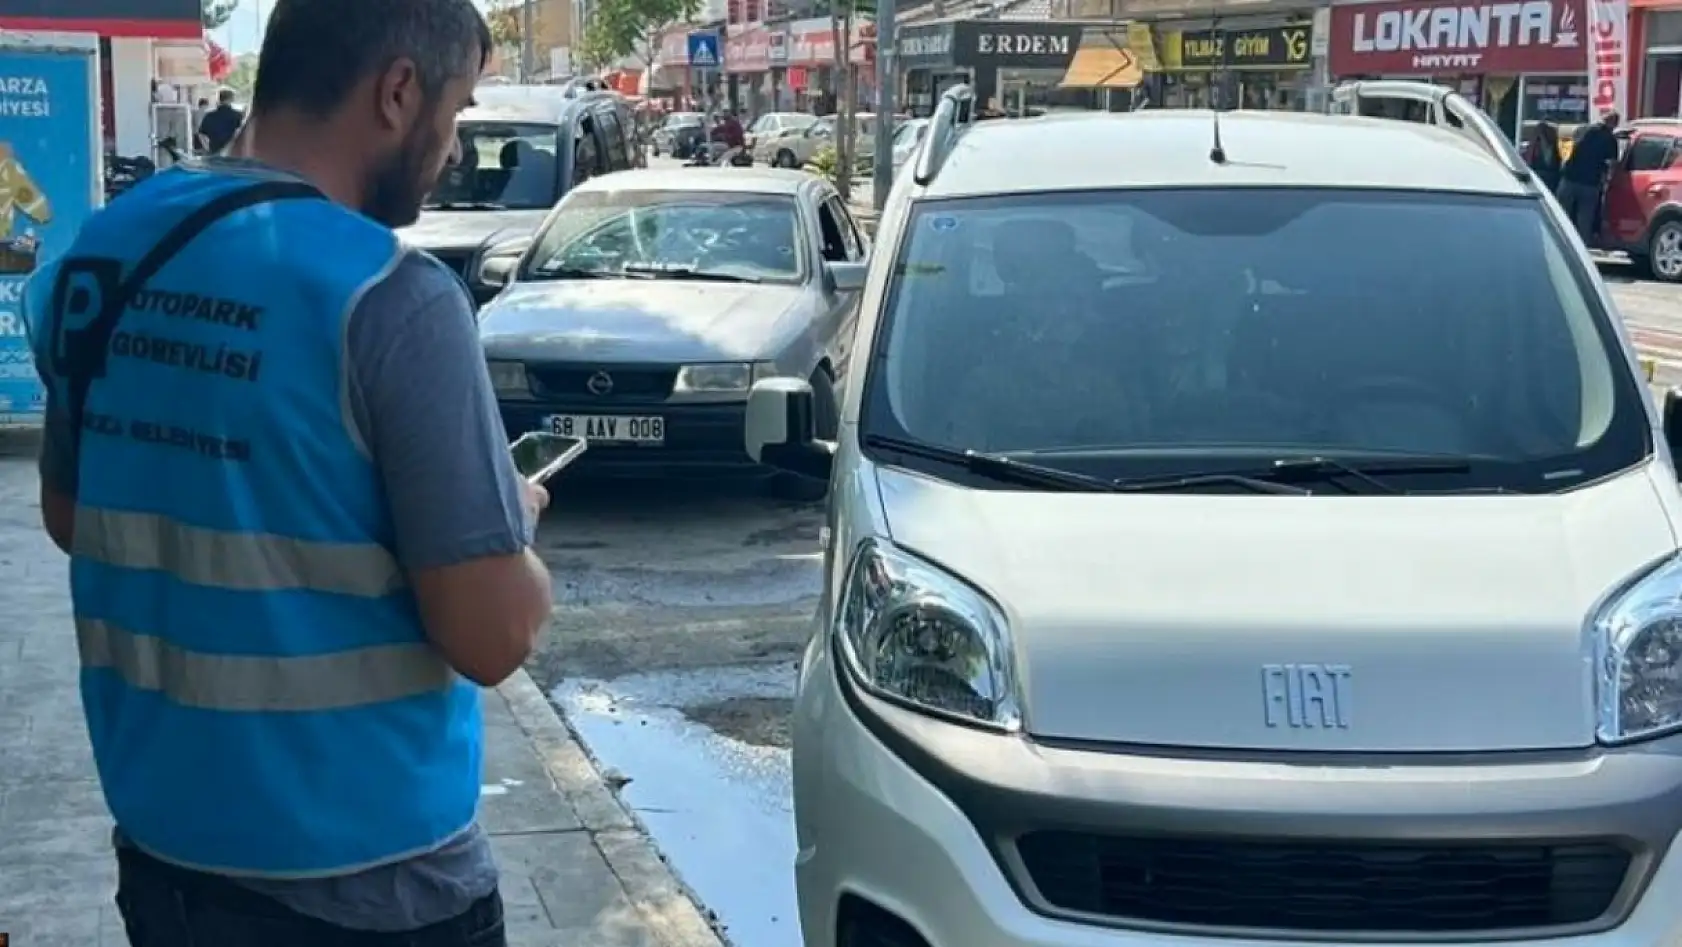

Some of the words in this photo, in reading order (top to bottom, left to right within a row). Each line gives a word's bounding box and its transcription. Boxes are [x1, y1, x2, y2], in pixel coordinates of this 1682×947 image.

[1353, 1, 1550, 52] LOKANTA
[977, 34, 1070, 55] ERDEM
[1282, 29, 1308, 61] YG
[1412, 53, 1483, 68] HAYAT
[129, 289, 264, 331] OTOPARK
[553, 416, 574, 437] 68
[585, 416, 617, 438] AAV
[629, 418, 663, 439] 008
[1260, 663, 1353, 729] FIAT
